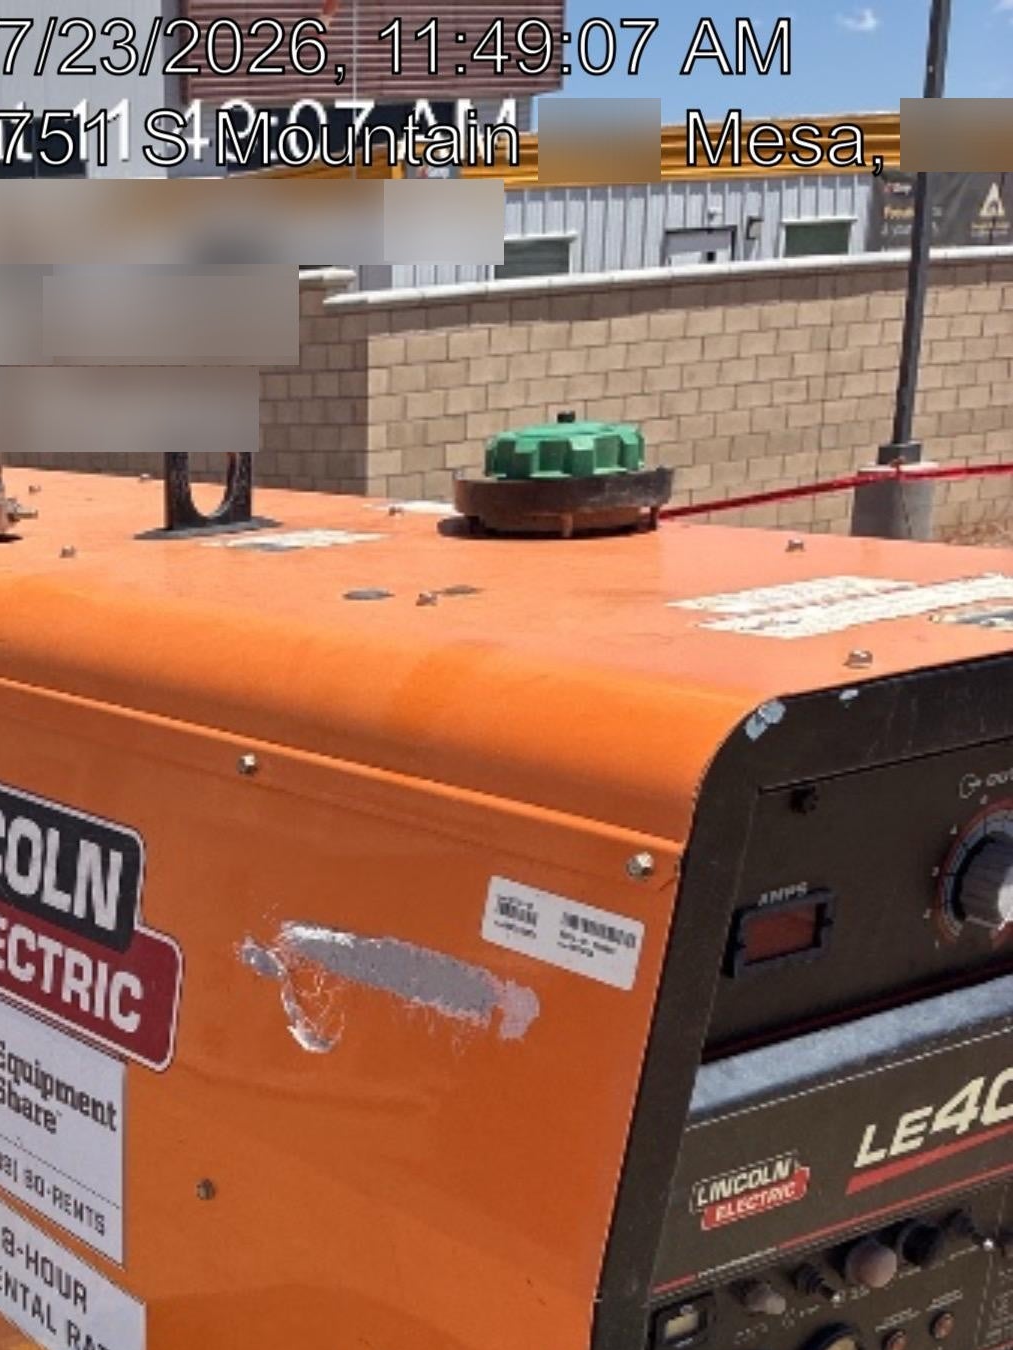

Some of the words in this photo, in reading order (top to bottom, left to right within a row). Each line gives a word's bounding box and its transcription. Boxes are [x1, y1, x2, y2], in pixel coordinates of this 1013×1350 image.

[757, 881, 809, 906] AMPS
[697, 1158, 793, 1207] LINCOLN
[715, 1181, 796, 1222] ELECTRIC
[0, 1225, 88, 1315] 8-HOUR
